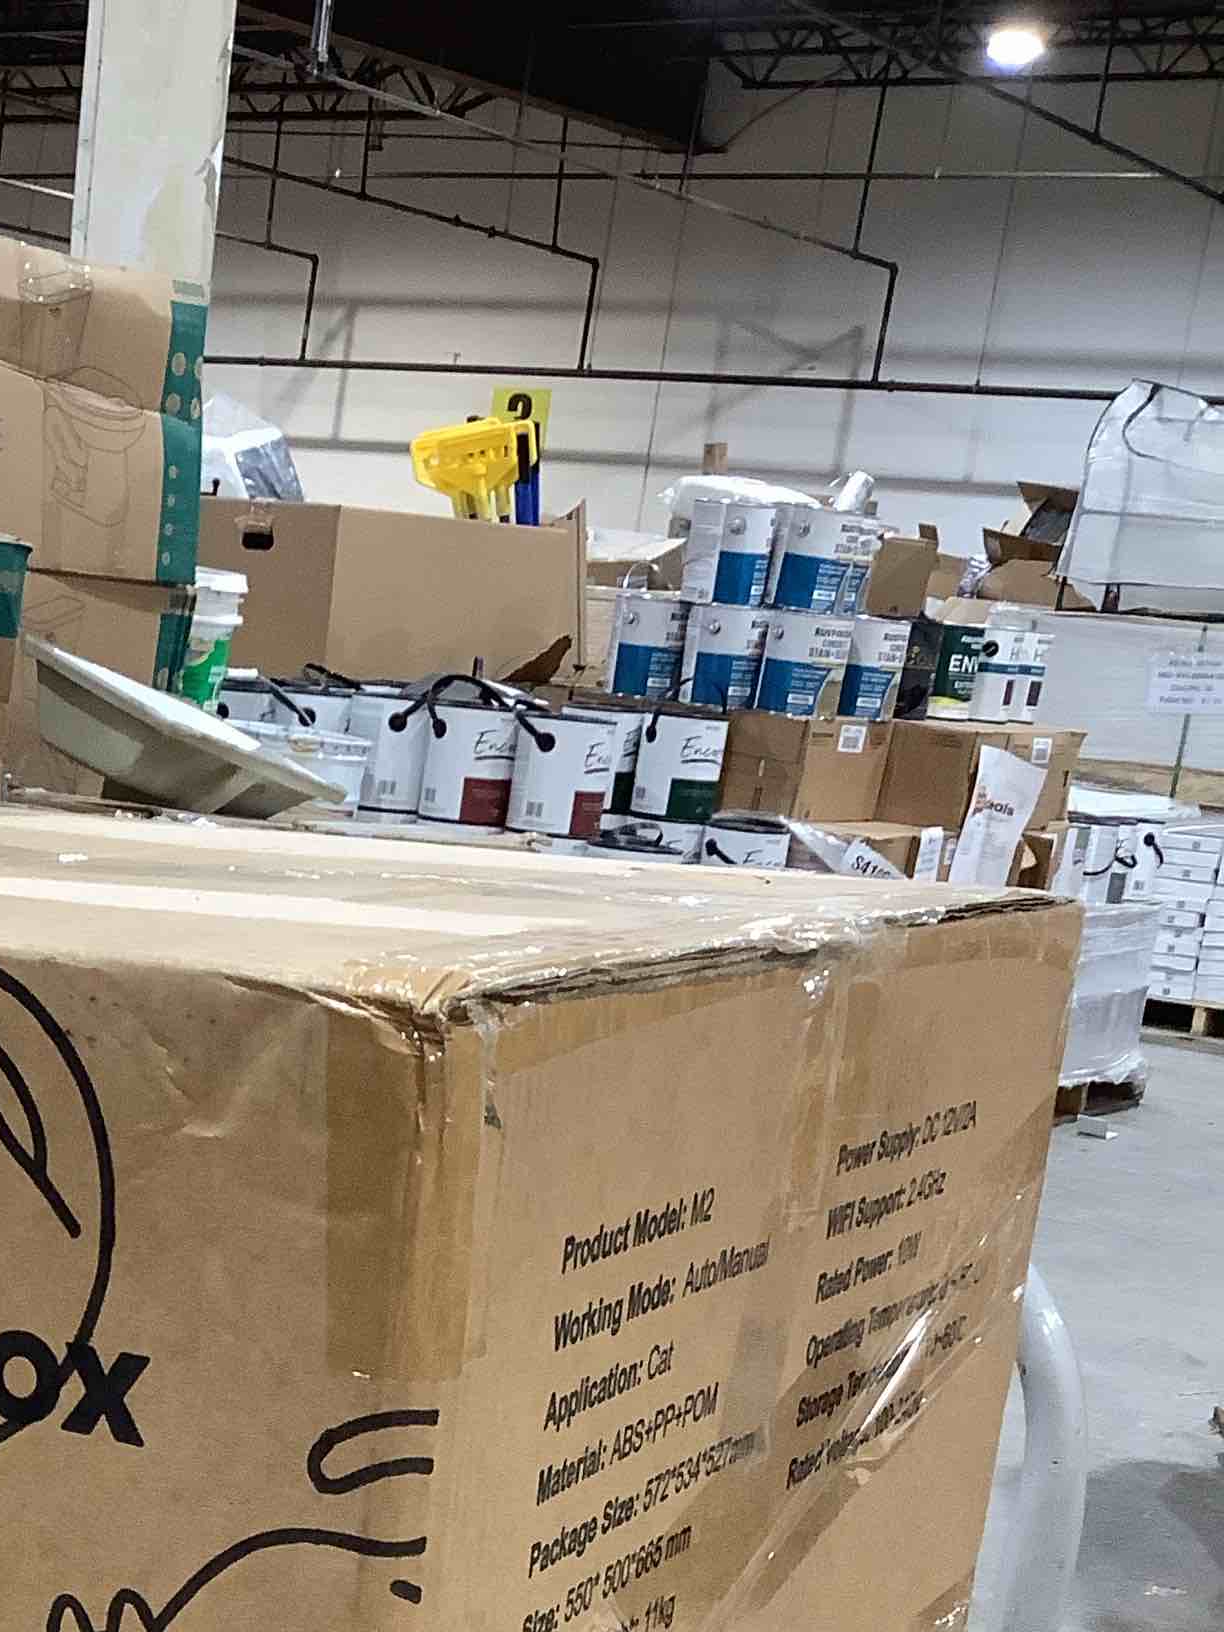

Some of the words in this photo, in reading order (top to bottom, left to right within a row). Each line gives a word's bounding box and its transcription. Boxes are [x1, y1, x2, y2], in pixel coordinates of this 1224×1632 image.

[561, 1218, 631, 1275] Product
[632, 1197, 687, 1247] Model:
[690, 1187, 716, 1227] M2
[554, 1297, 624, 1352] Working
[626, 1274, 677, 1322] Mode:
[543, 1359, 644, 1432] Application:
[647, 1340, 675, 1381] Cat
[536, 1440, 607, 1506] Material:
[610, 1381, 720, 1466] ABS+PP+POM
[528, 1516, 599, 1579] Package
[601, 1493, 640, 1536] Size:
[665, 1525, 693, 1561] mm
